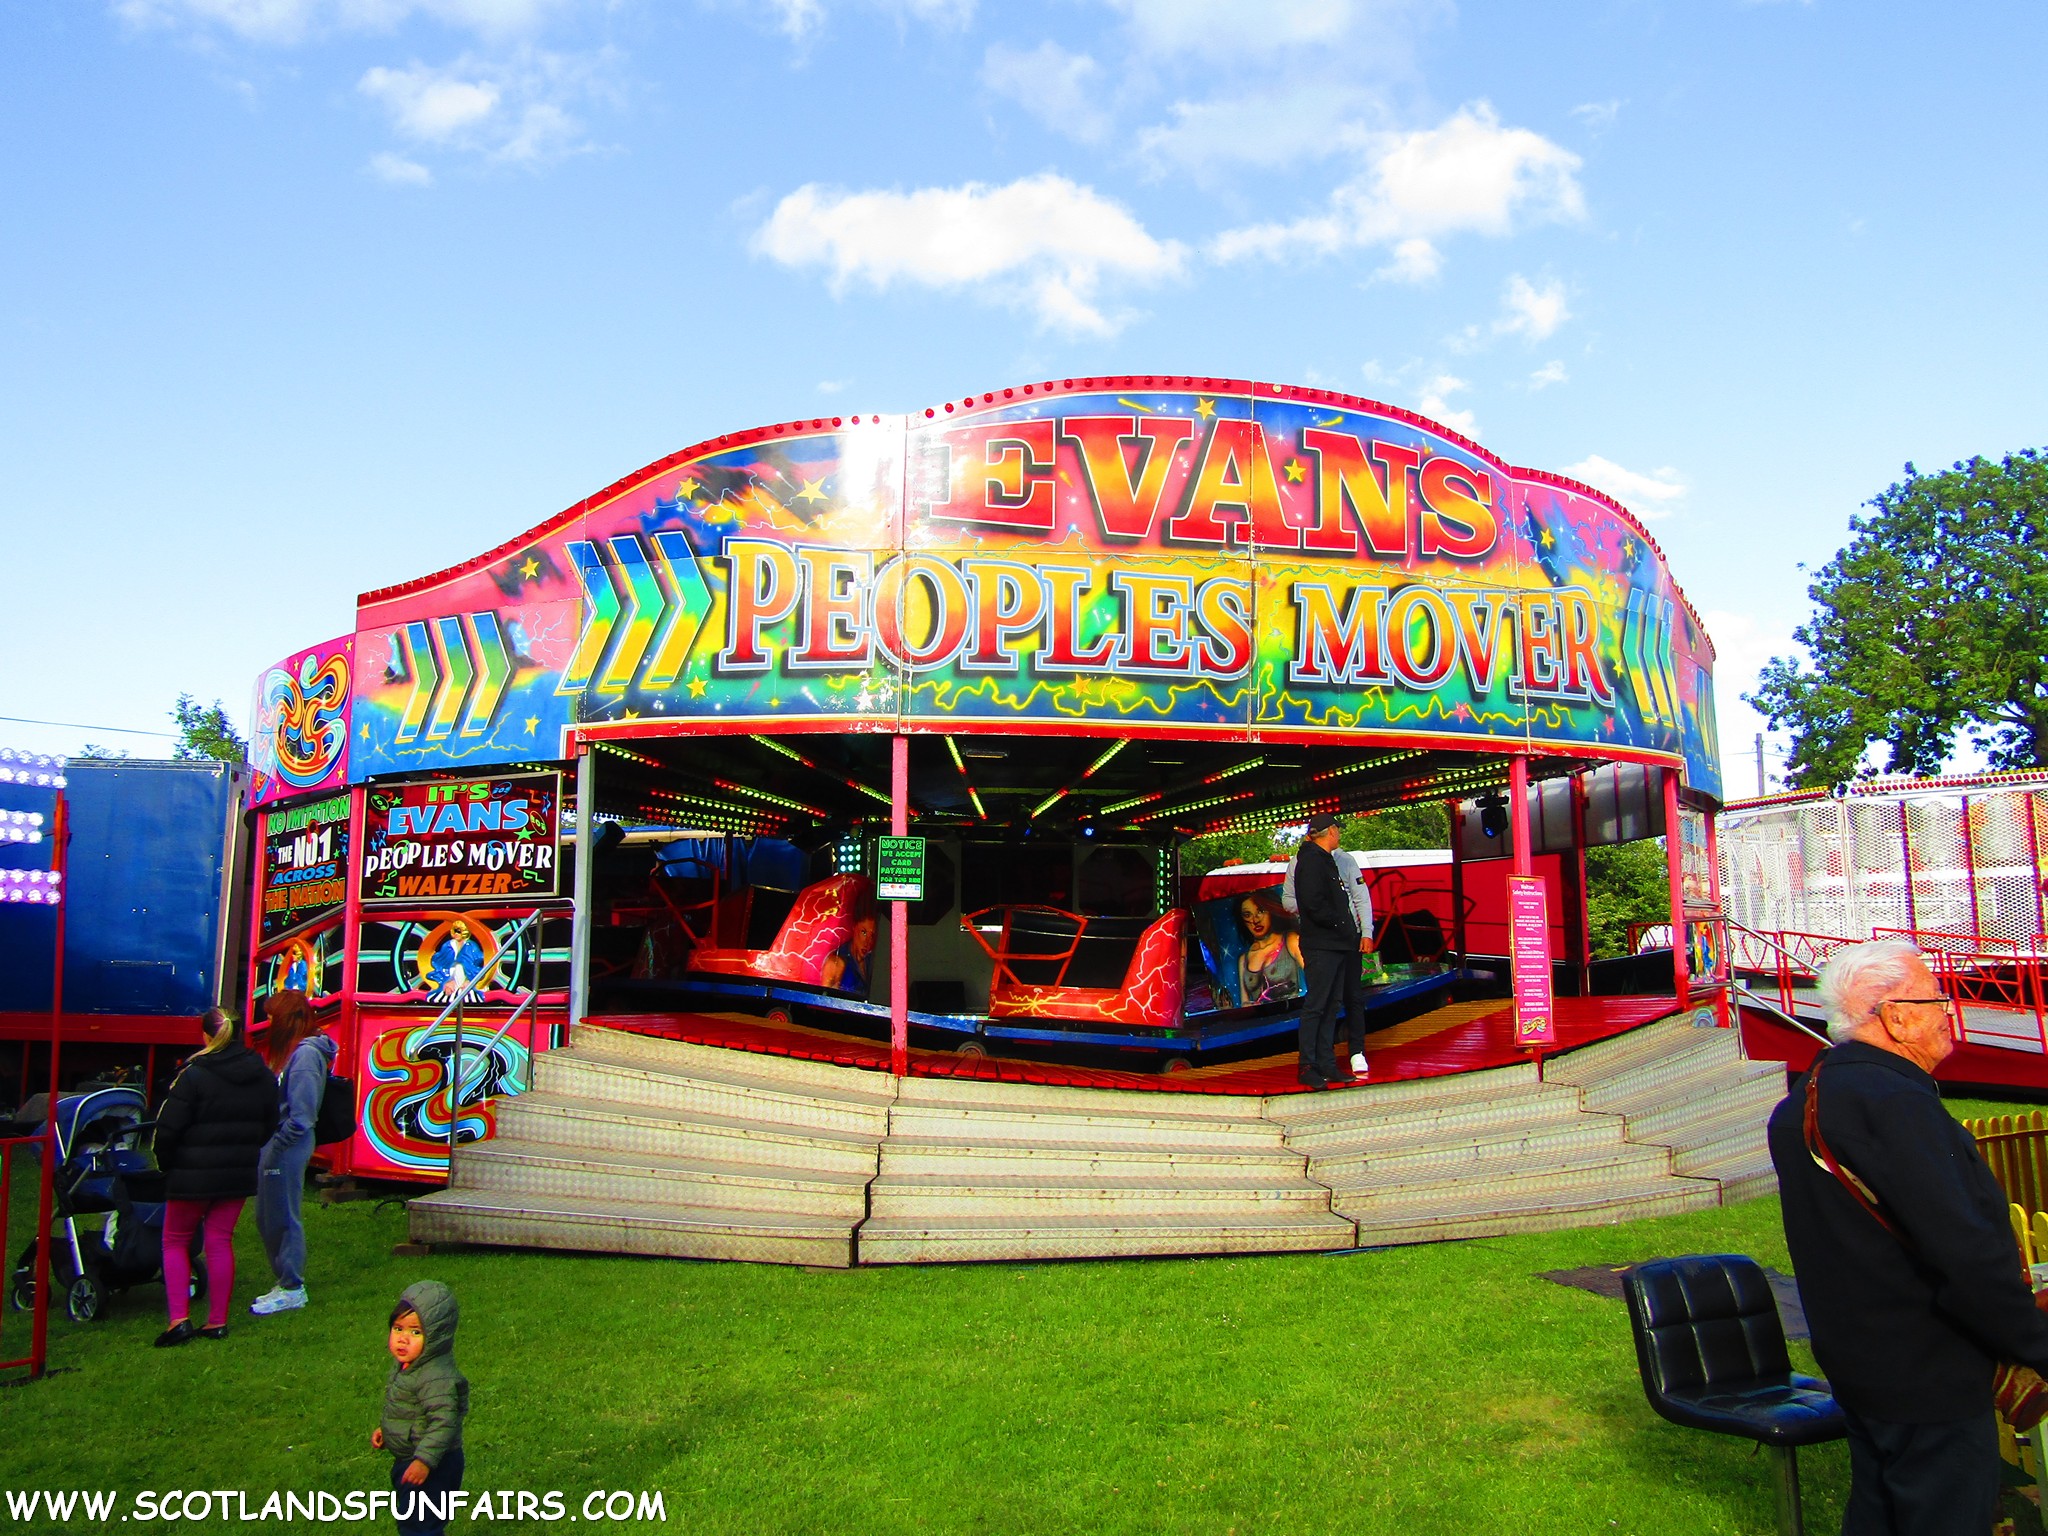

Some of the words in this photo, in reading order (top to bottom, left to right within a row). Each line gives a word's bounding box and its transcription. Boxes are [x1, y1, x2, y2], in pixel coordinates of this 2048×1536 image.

[926, 415, 1497, 557] EVANS
[718, 535, 1259, 679] PEOPLES
[1290, 581, 1616, 708] MOVER
[427, 782, 490, 804] IT'S
[267, 811, 287, 837] NO
[286, 794, 351, 833] IMITATION
[388, 799, 530, 836] EVANS
[278, 845, 293, 864] THE
[293, 826, 332, 869] NO.1
[364, 840, 465, 878] PEOPLES
[467, 841, 553, 872] MOVER
[882, 840, 922, 850] NOTICE
[272, 863, 337, 885] ACROSS
[399, 873, 512, 896] WALTZER
[265, 887, 288, 913] THE
[289, 877, 346, 910] NATION
